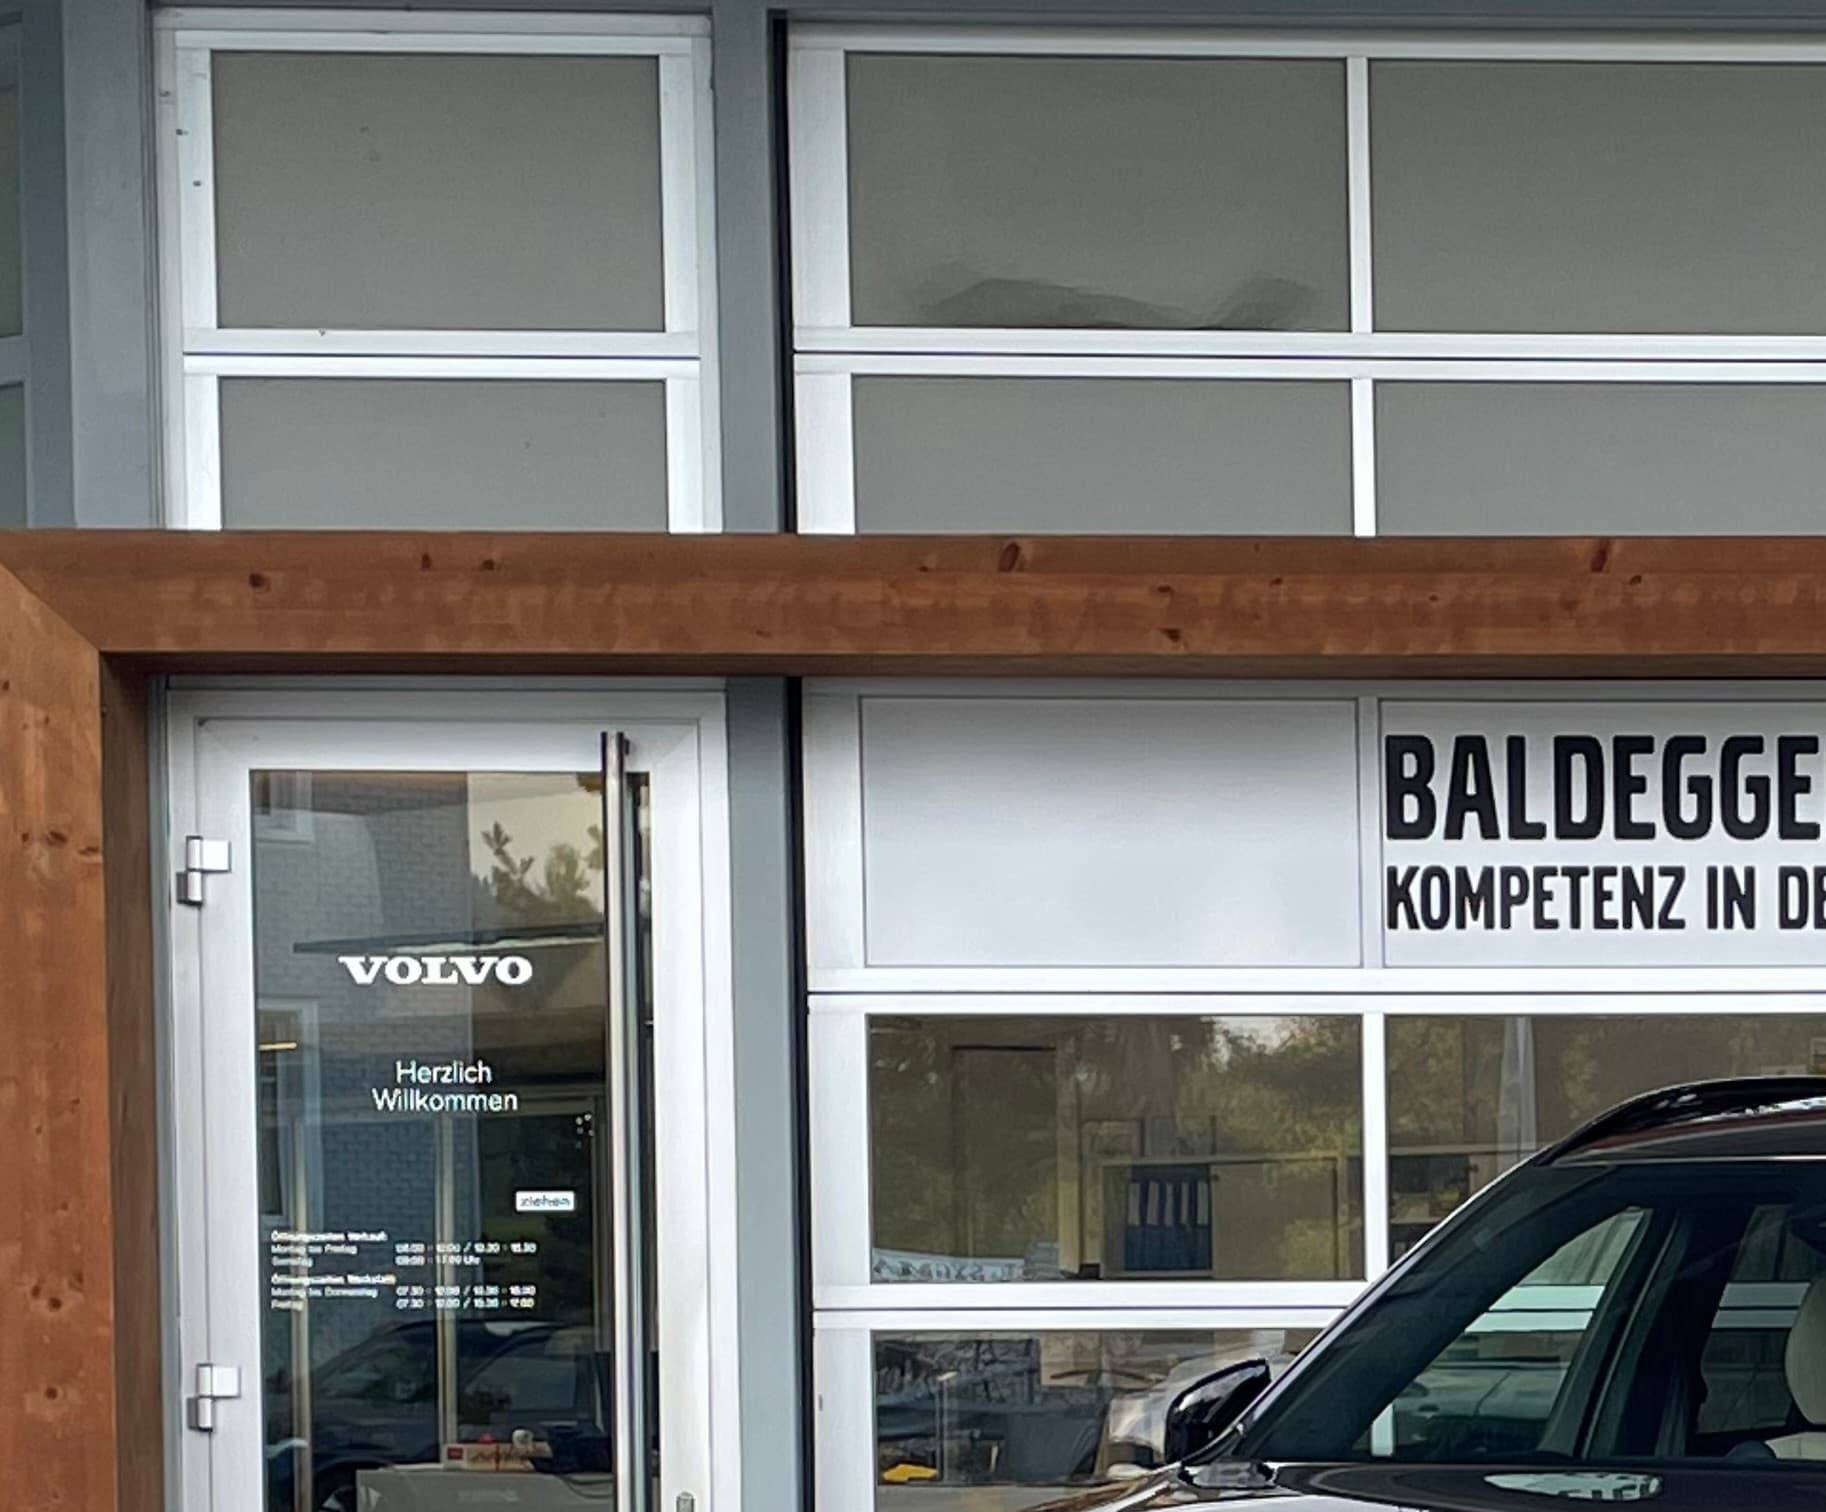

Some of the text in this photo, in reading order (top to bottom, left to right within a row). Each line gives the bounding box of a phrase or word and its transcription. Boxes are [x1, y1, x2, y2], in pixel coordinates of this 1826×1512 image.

[1386, 865, 1685, 931] KOMPETENZ
[1706, 865, 1756, 931] IN
[337, 955, 533, 985] VOLVO
[395, 1060, 493, 1084] Herzlich
[371, 1087, 518, 1112] Willkommen
